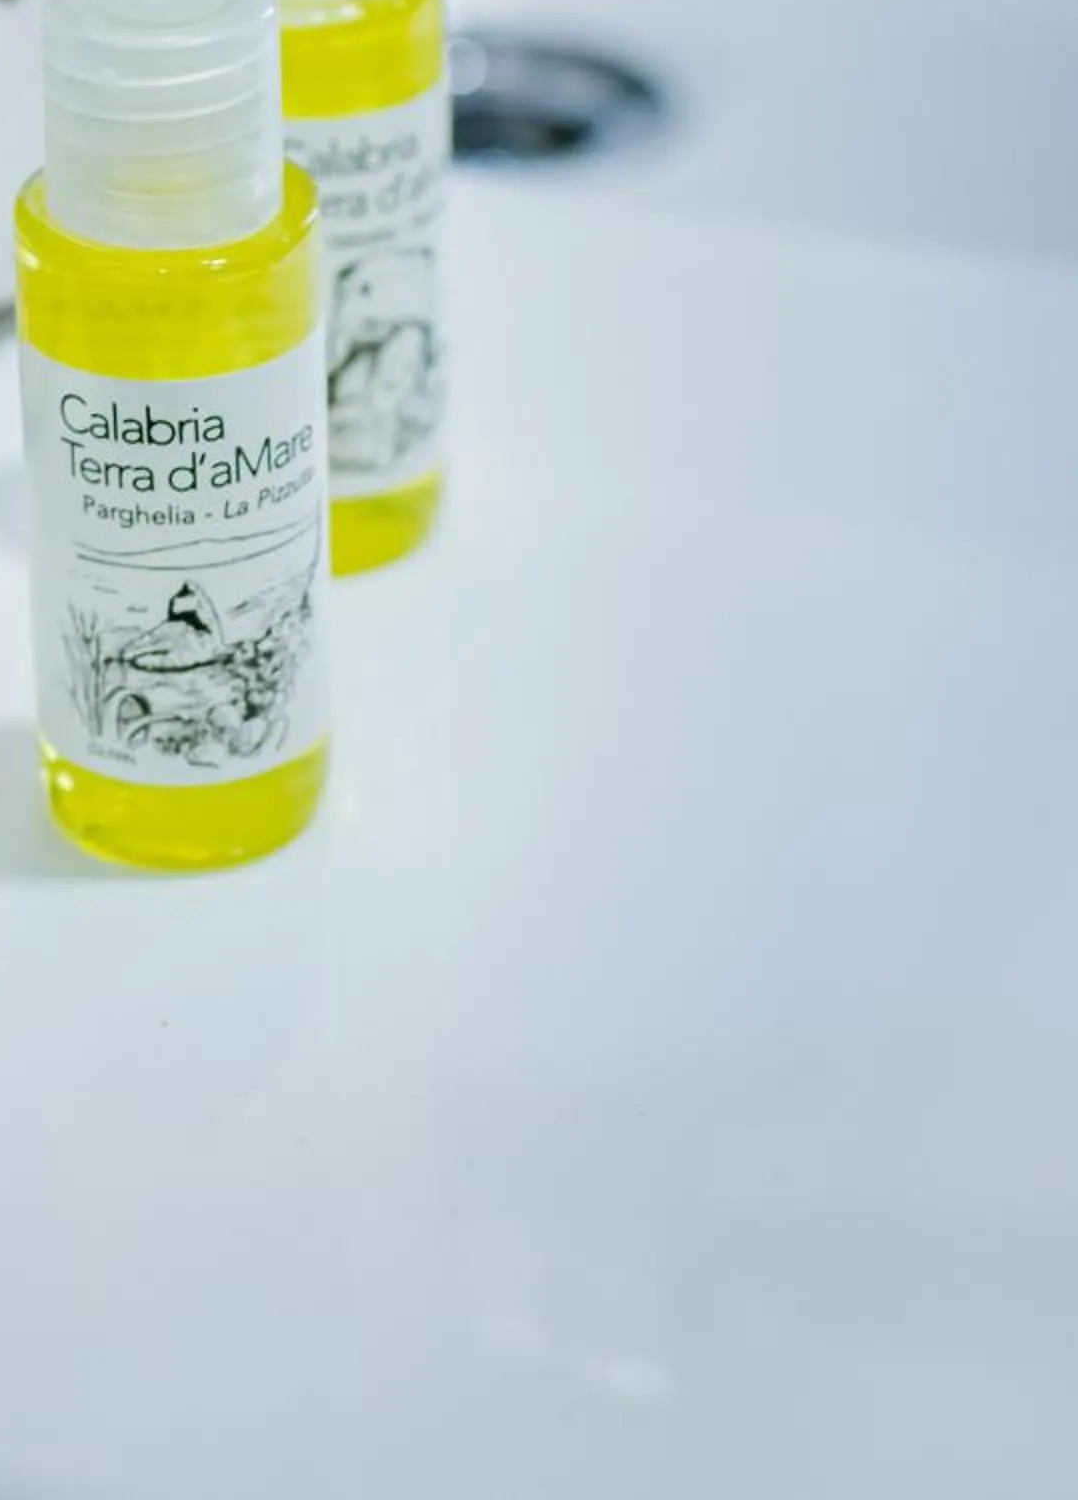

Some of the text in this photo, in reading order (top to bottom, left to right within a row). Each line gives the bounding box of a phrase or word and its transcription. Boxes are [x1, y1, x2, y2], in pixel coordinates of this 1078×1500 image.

[60, 393, 225, 446] Calabria
[60, 437, 155, 492] Terra
[82, 494, 195, 529] Parghelia
[223, 499, 249, 519] La
